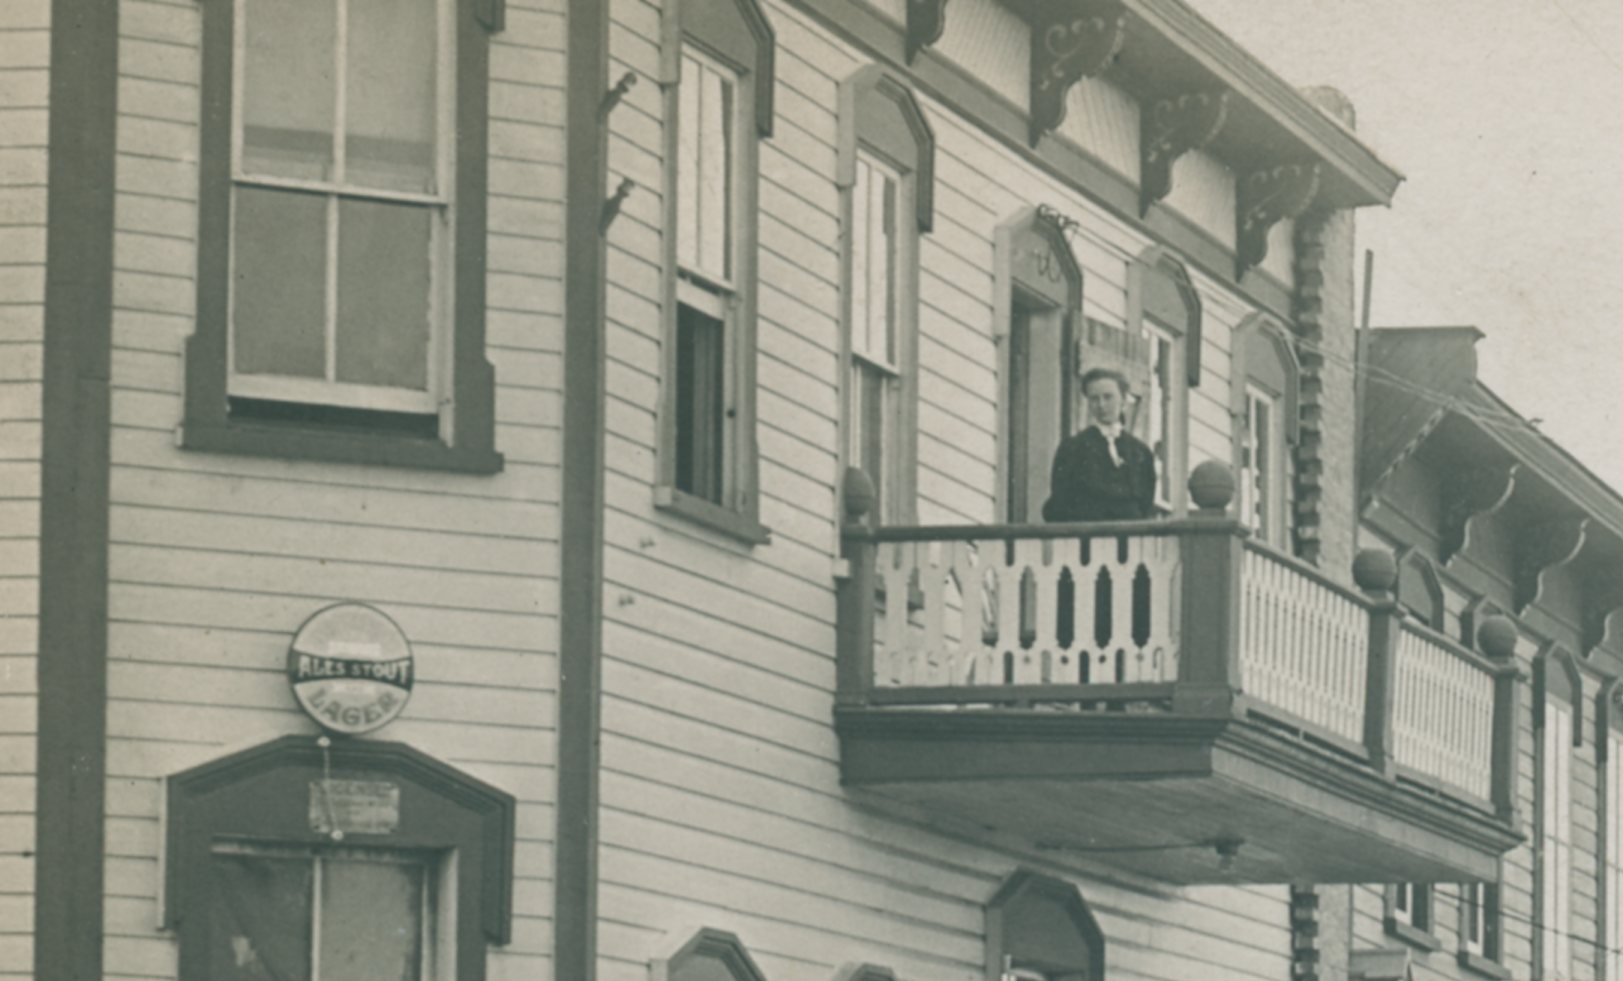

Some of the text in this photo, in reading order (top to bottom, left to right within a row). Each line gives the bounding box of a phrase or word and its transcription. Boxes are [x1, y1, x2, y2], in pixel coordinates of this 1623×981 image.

[299, 655, 411, 685] ALES STOUT
[308, 688, 399, 727] LAGER
